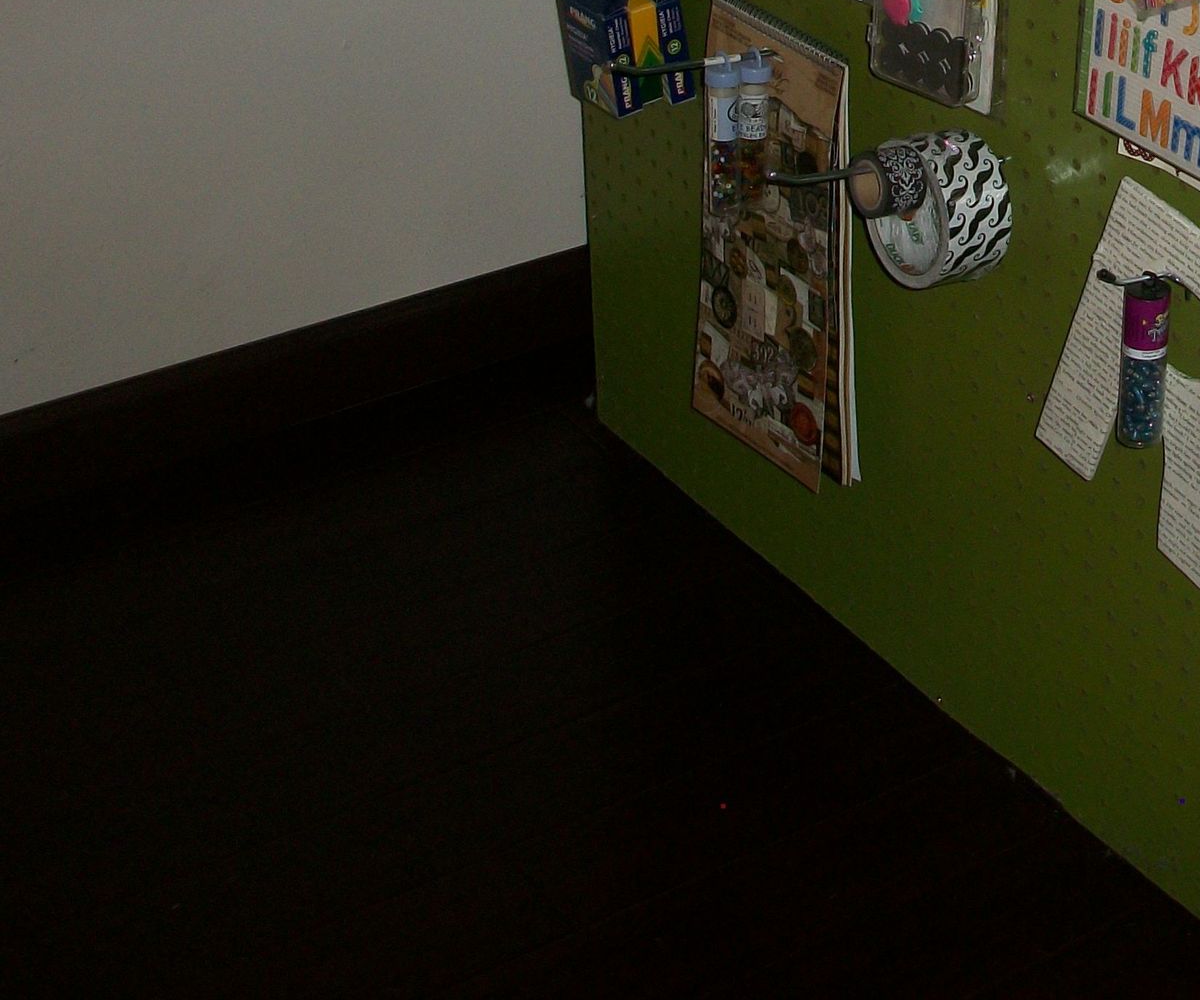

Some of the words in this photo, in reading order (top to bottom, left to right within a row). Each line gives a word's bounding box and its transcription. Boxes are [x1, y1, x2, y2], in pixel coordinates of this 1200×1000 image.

[669, 40, 680, 54] 12
[620, 75, 633, 110] PRANG
[674, 70, 685, 95] PRAN
